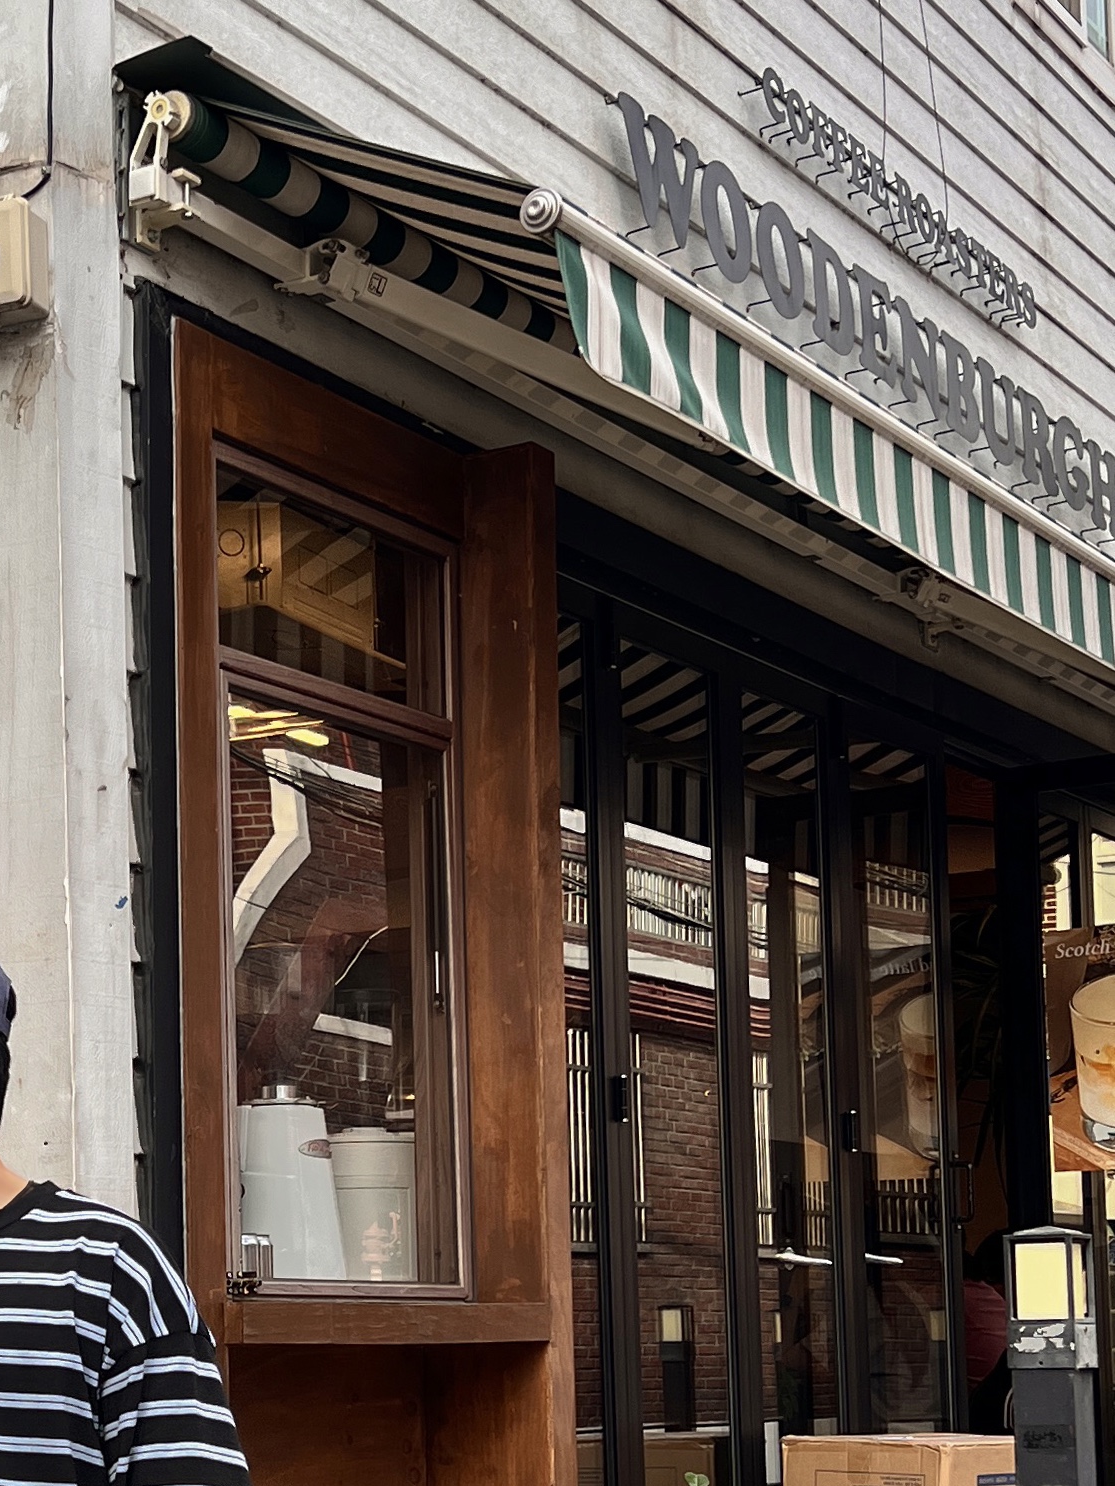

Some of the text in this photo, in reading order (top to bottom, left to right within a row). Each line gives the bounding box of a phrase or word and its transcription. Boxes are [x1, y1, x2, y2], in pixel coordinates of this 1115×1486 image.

[617, 91, 1115, 540] WOODENBURGH
[762, 67, 1037, 329] COFFEE ROASTERS
[1054, 938, 1111, 959] Scotch
